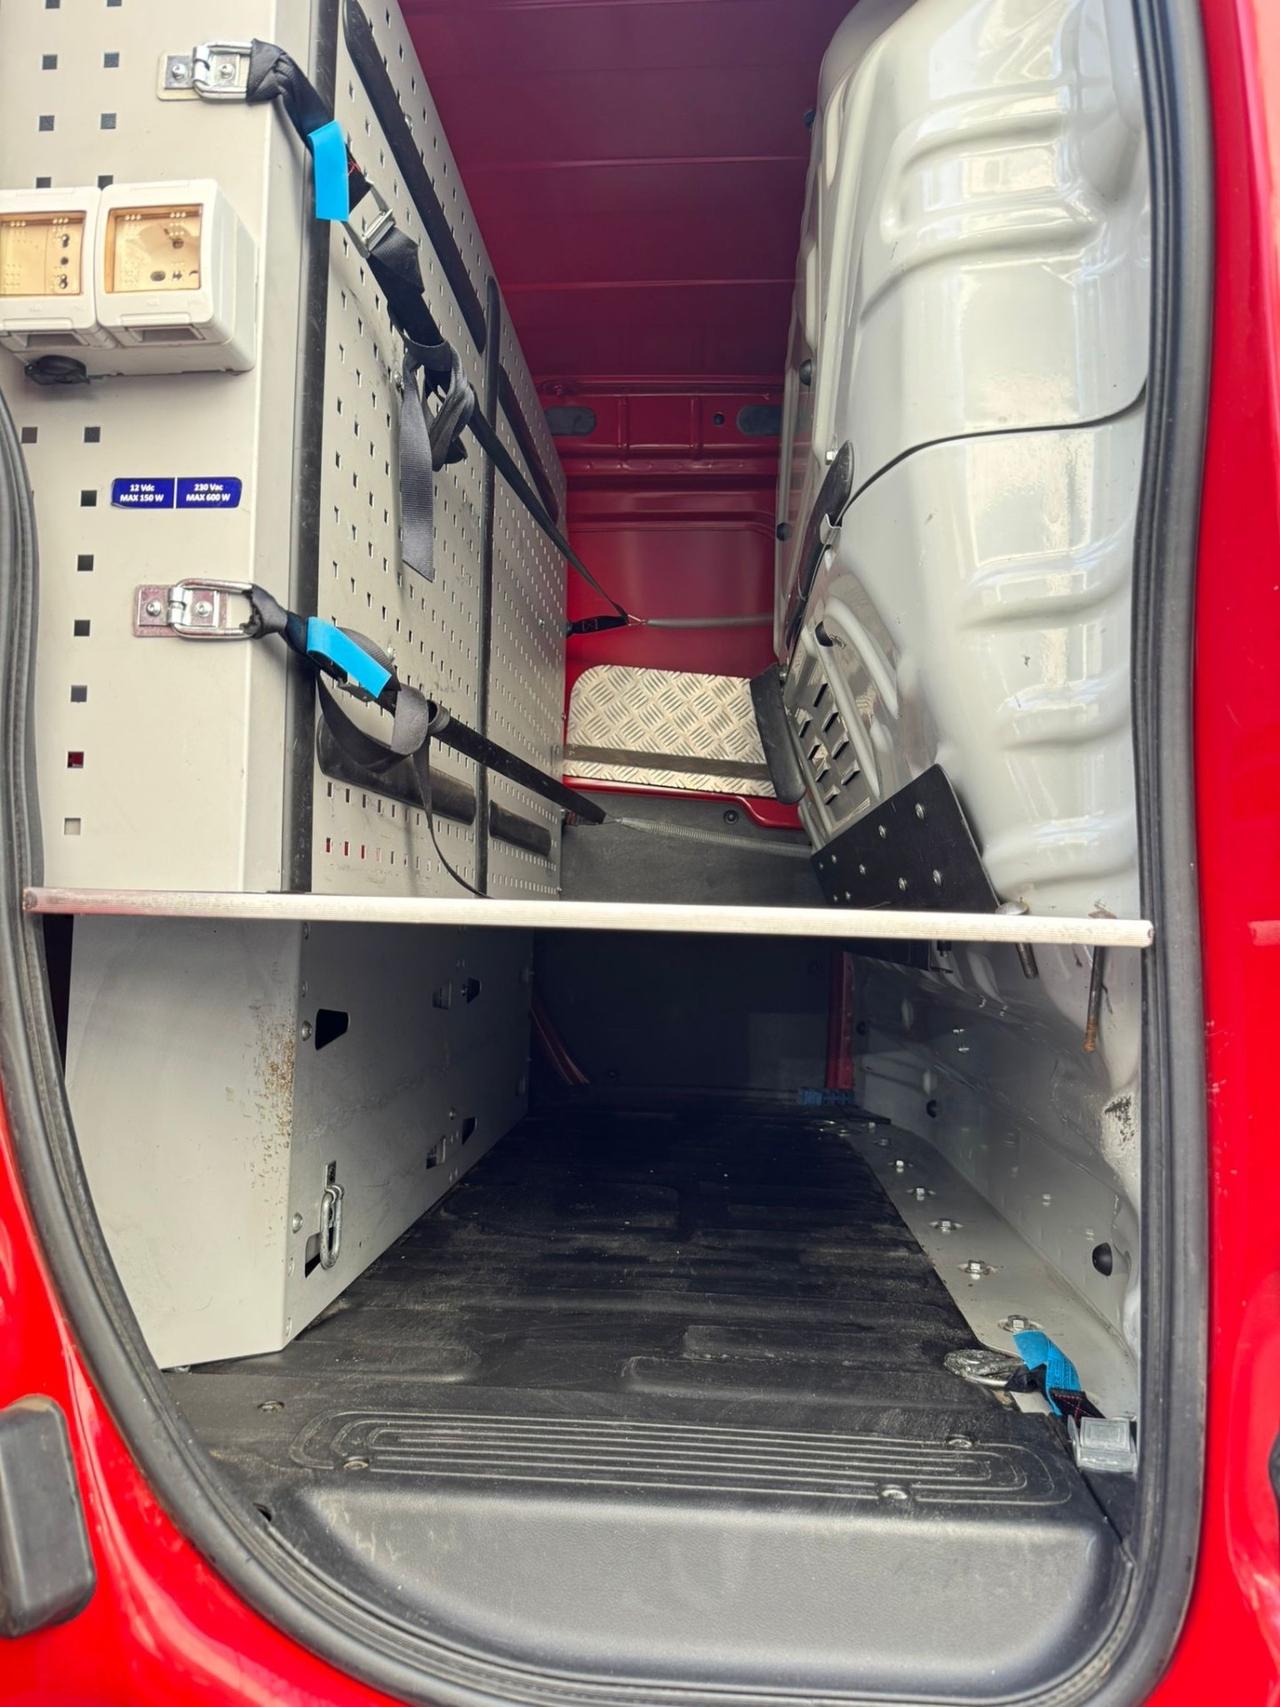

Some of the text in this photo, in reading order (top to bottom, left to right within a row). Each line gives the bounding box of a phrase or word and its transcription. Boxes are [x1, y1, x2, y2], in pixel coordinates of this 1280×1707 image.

[130, 484, 155, 492] 12 Vdc
[194, 484, 208, 492] 230
[120, 494, 164, 502] MAX 150 W
[186, 493, 231, 502] MAX 600 W
